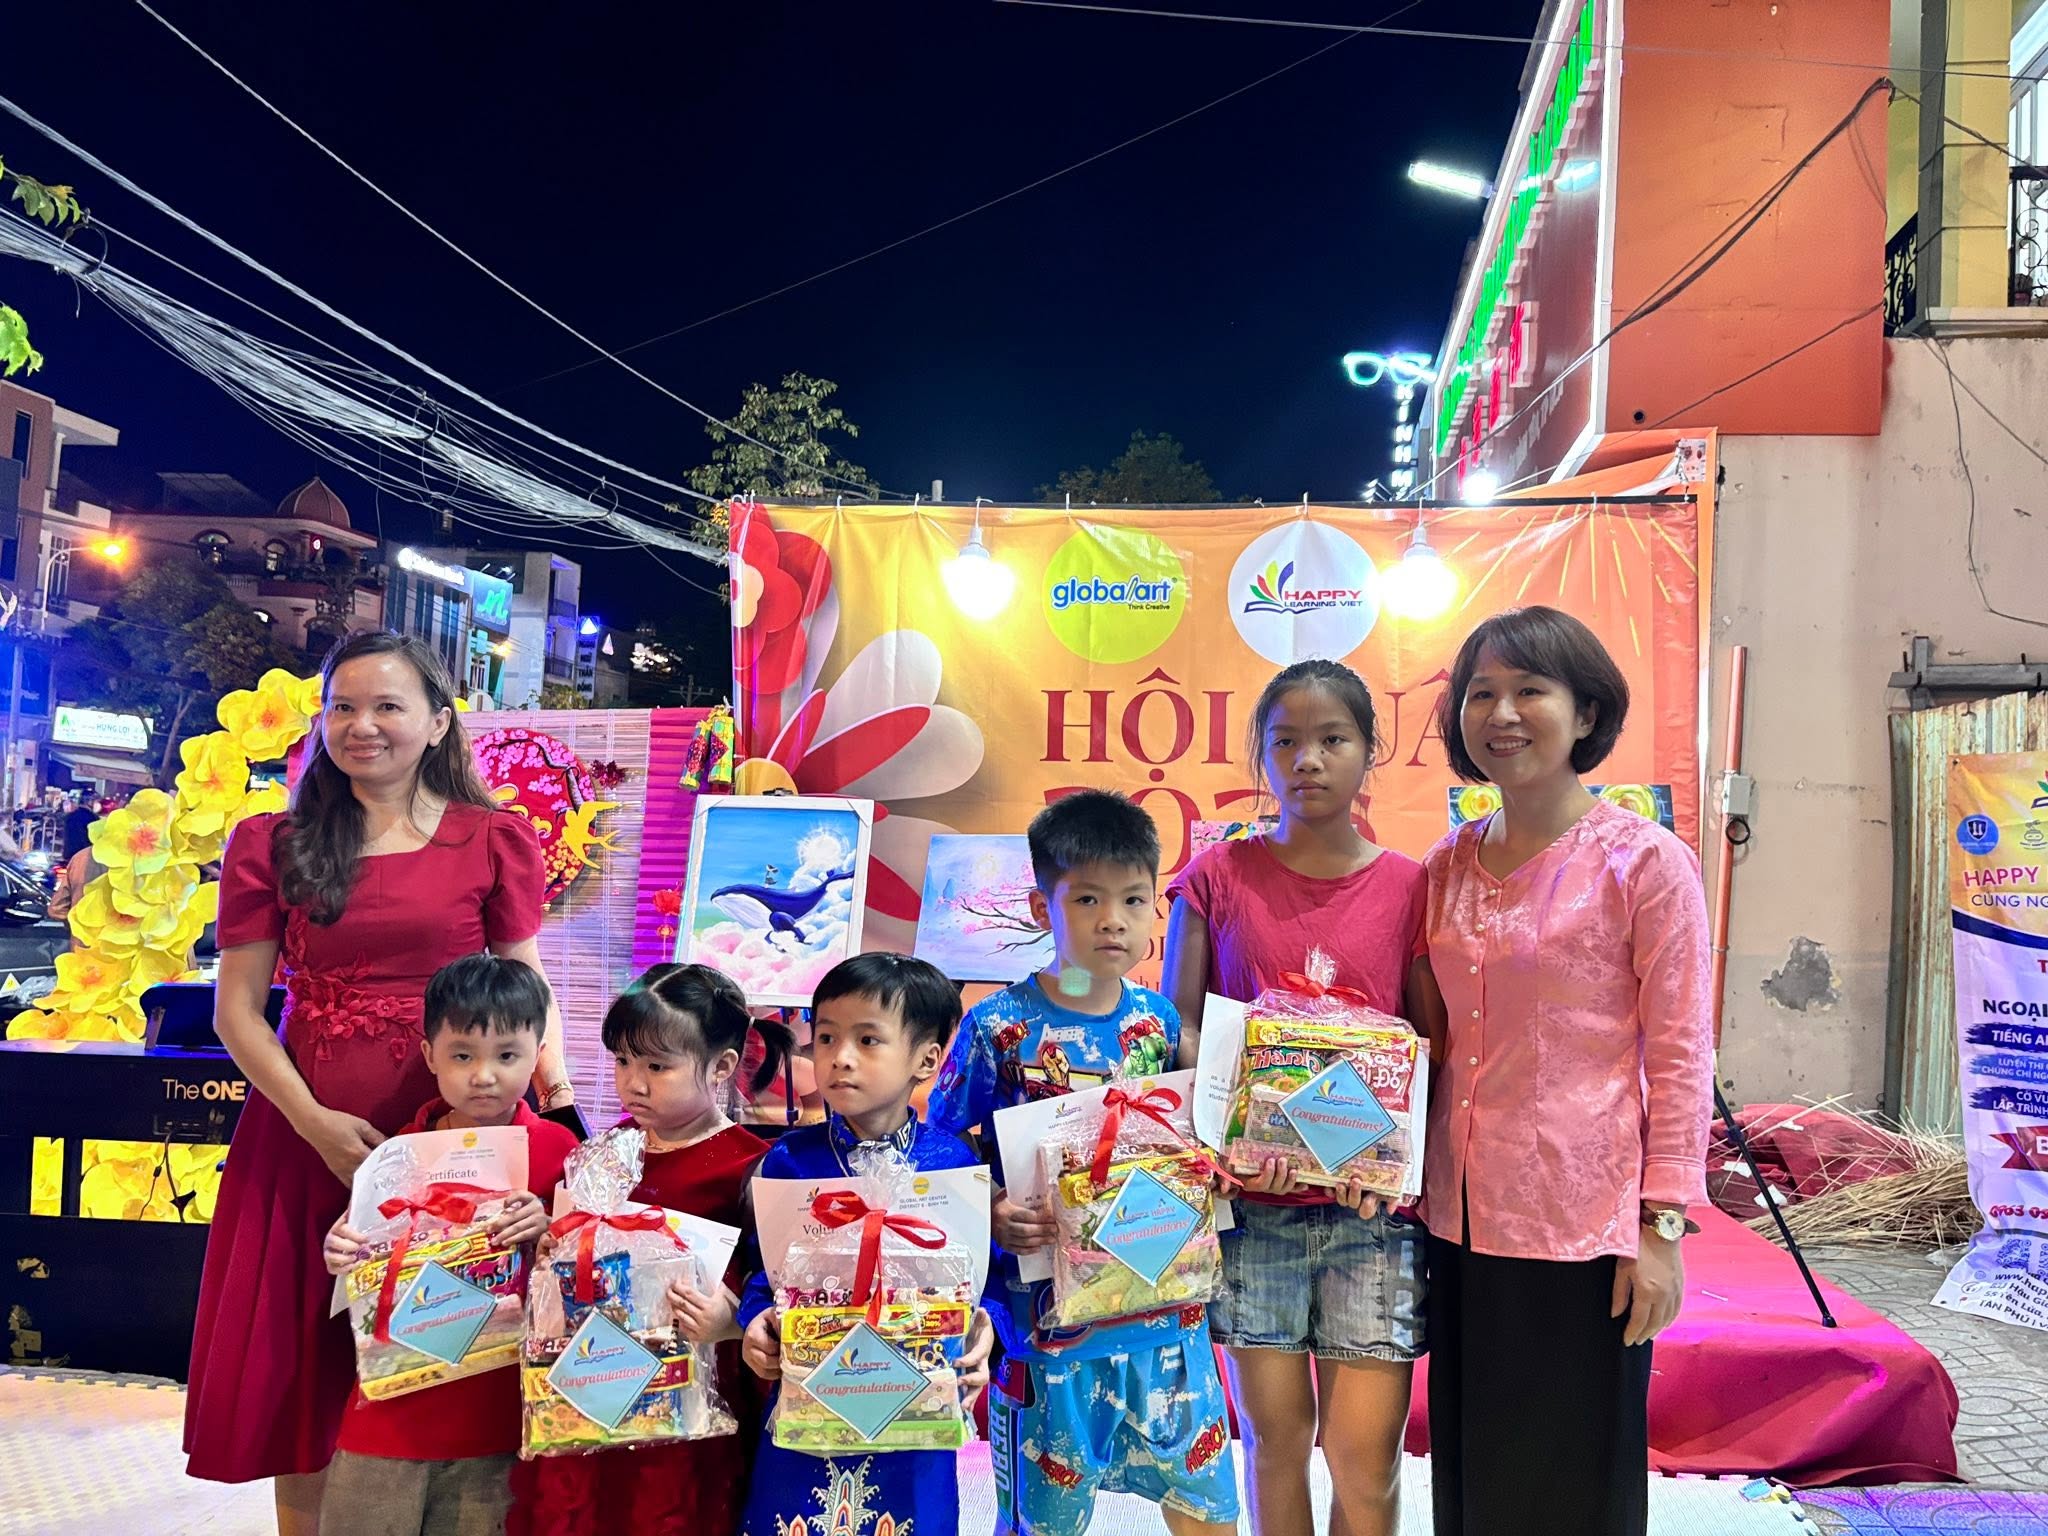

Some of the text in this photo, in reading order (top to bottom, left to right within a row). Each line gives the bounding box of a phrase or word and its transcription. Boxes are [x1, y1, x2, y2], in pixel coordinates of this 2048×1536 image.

[1285, 591, 1362, 600] HAPPY
[1040, 667, 1234, 782] HỘI
[1964, 866, 2038, 887] HAPPY
[1983, 998, 2048, 1022] NGOẠI
[1992, 1028, 2032, 1045] TIẾNG
[162, 1079, 246, 1100] The ONE
[1291, 1106, 1384, 1133] Congratulations!
[559, 1362, 651, 1389] Congratulations!
[815, 1380, 916, 1397] Congratulations!
[1185, 1415, 1227, 1476] HERO!
[1036, 1450, 1085, 1491] HERO!
